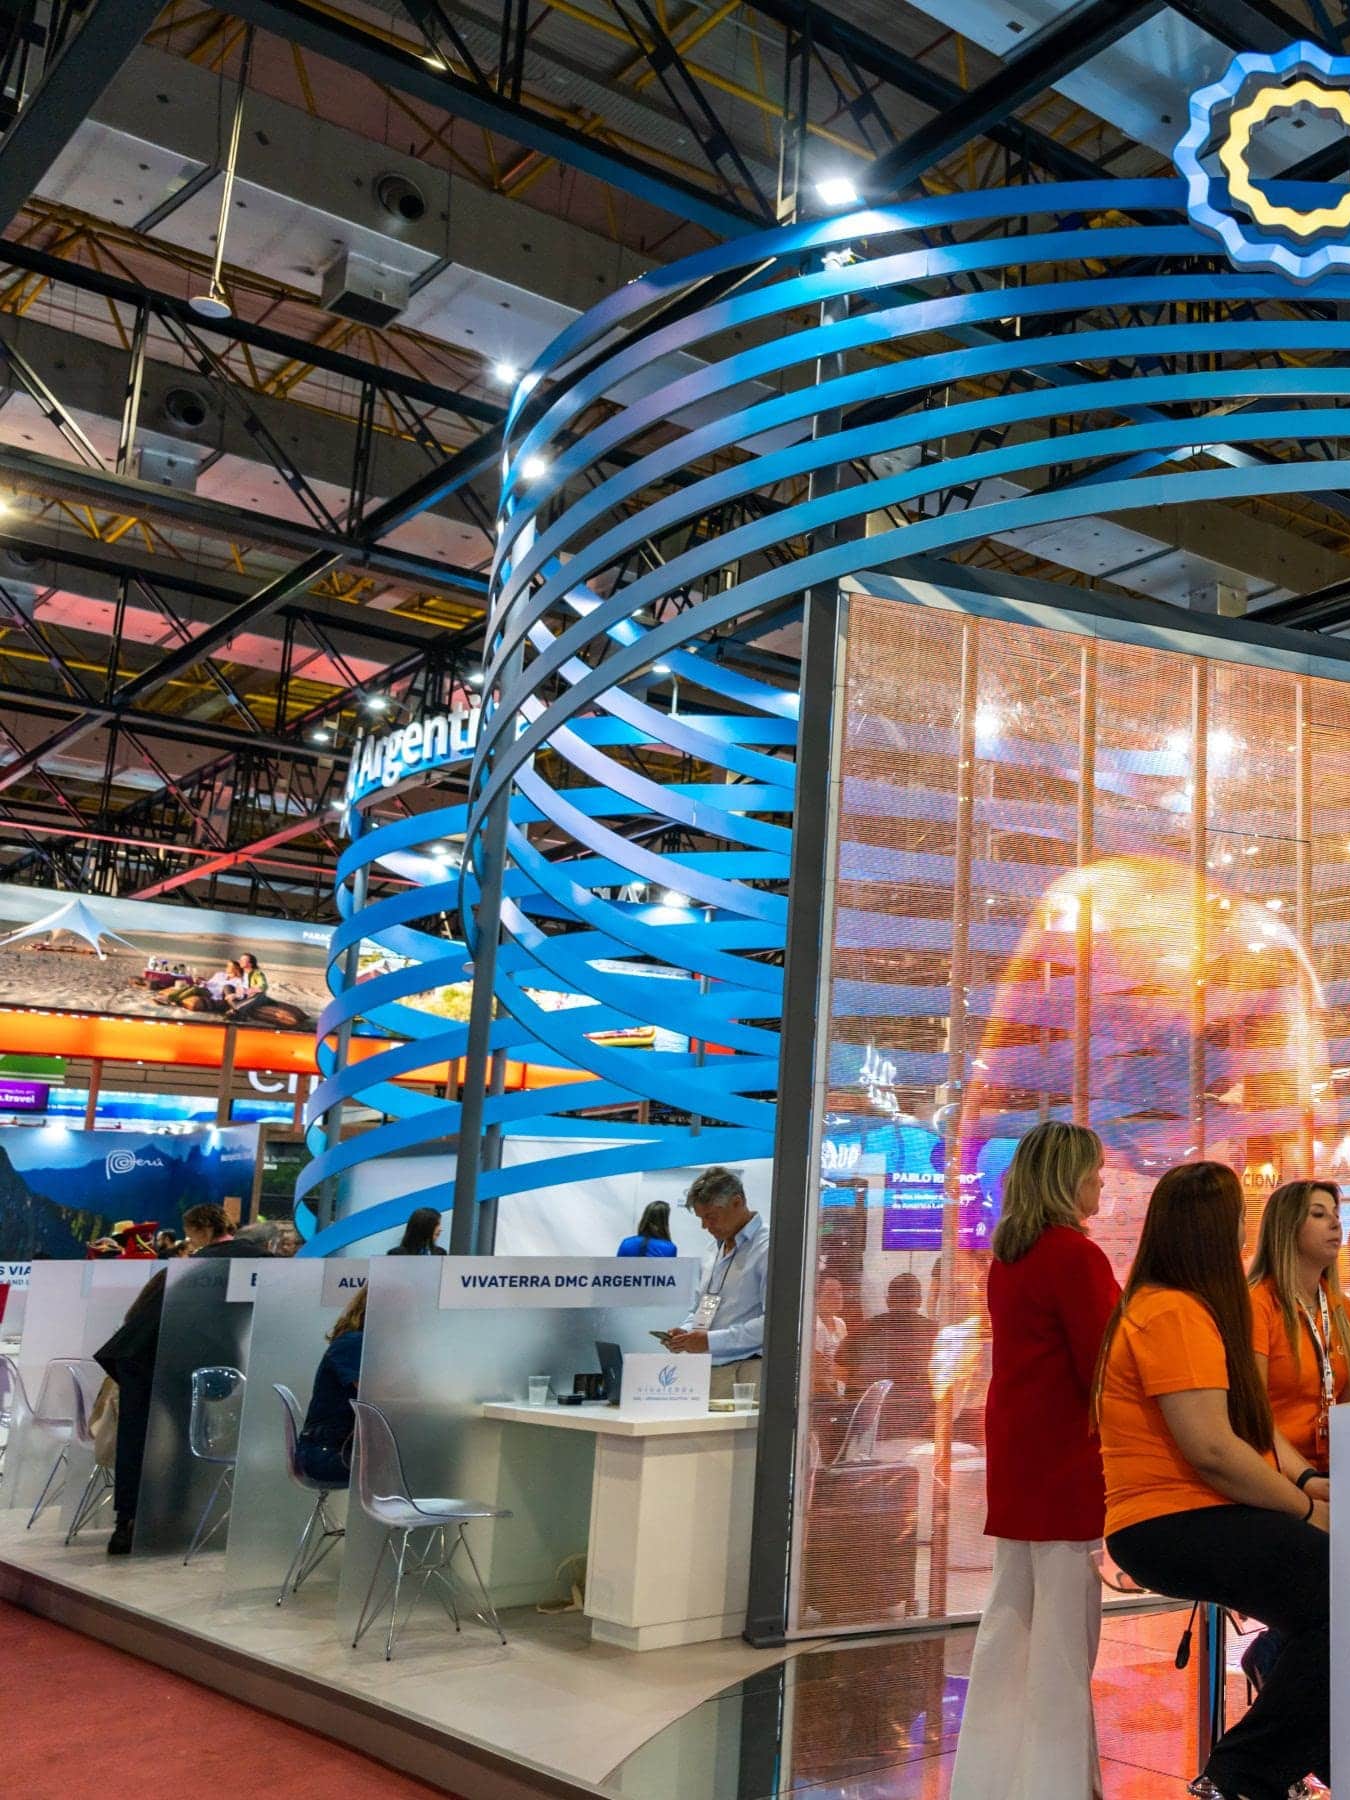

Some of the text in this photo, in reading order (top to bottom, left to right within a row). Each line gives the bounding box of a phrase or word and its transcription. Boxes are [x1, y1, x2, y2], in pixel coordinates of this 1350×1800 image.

[359, 693, 484, 788] Argenti
[460, 1274, 677, 1288] VIVATERRA DMC ARGENTINA
